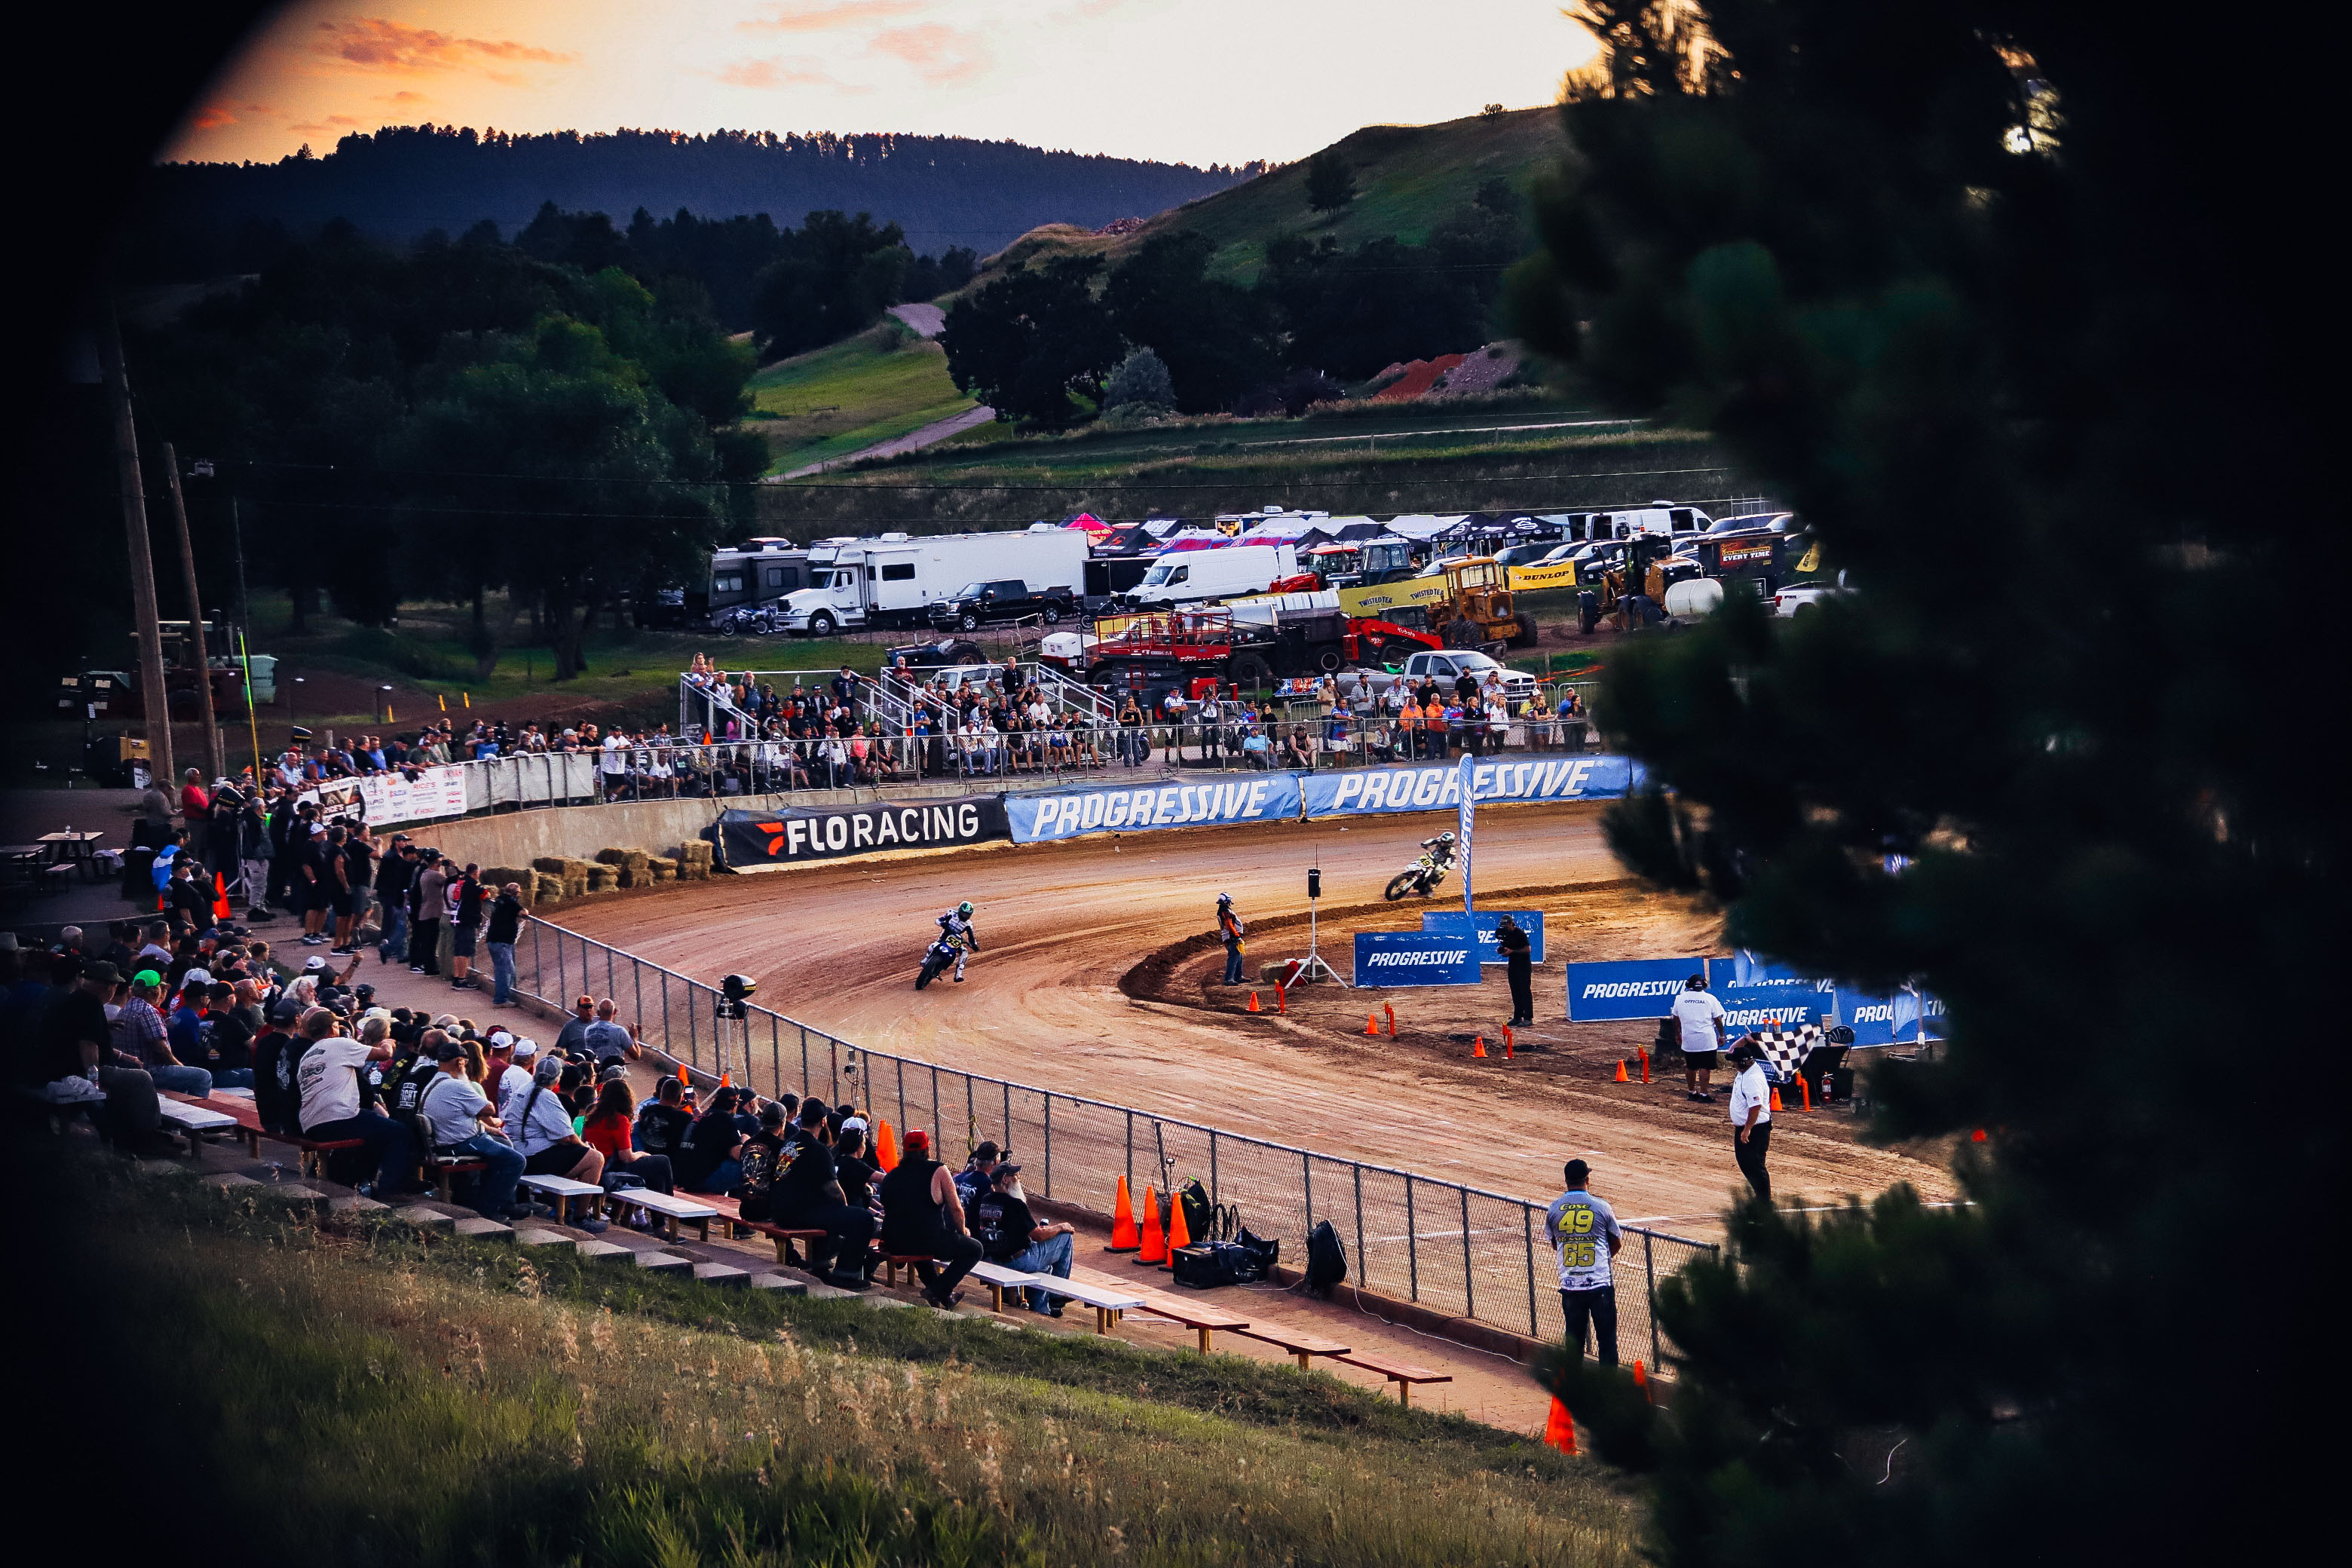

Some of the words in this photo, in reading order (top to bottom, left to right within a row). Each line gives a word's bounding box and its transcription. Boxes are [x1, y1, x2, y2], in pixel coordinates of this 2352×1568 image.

[1723, 553, 1748, 562] EVERY
[1750, 550, 1770, 559] TIME
[1523, 571, 1570, 580] DUNLOP
[1410, 589, 1433, 600] TWISTED
[1432, 588, 1444, 596] TEA
[1358, 596, 1383, 608] TWISTED
[1382, 596, 1393, 605] TEA
[1397, 627, 1416, 637] Kubota
[1332, 760, 1595, 810] PROGRESSIVE
[1031, 780, 1269, 838] PROGRESSIVE
[787, 804, 978, 855] FLORACING
[1420, 858, 1431, 867] 49
[1367, 951, 1468, 966] PROGRESSIVE
[1558, 1210, 1594, 1234] 49
[1563, 1242, 1596, 1267] 65
